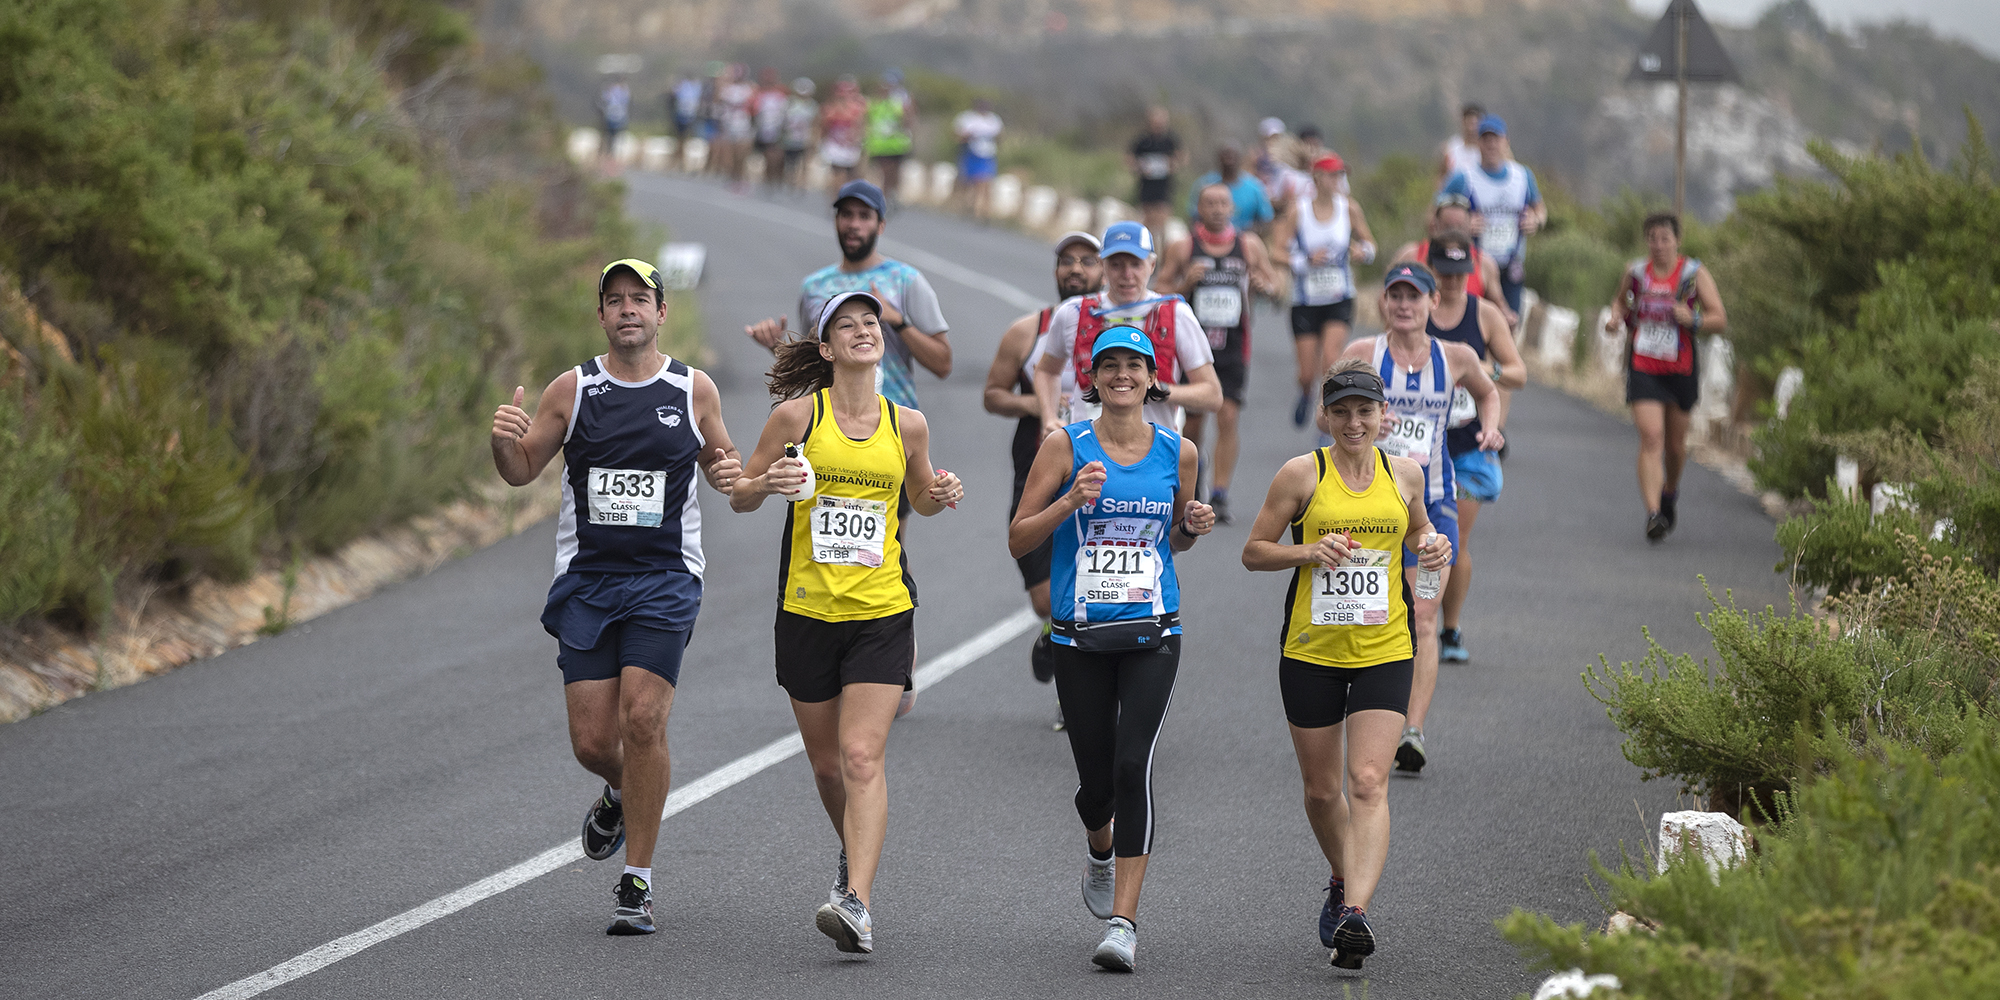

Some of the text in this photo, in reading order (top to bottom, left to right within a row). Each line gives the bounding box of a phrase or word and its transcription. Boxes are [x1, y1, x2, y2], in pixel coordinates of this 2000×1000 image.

[588, 384, 612, 397] BLK
[597, 472, 655, 498] 1533
[815, 473, 894, 490] DURBANVILLE
[1101, 497, 1171, 516] Sanlam
[599, 512, 628, 522] STBB
[819, 511, 877, 541] 1309
[819, 549, 849, 559] STBB
[1087, 549, 1144, 574] 1211
[1321, 570, 1380, 596] 1308
[1087, 590, 1119, 600] STBB
[1323, 611, 1355, 622] STBB
